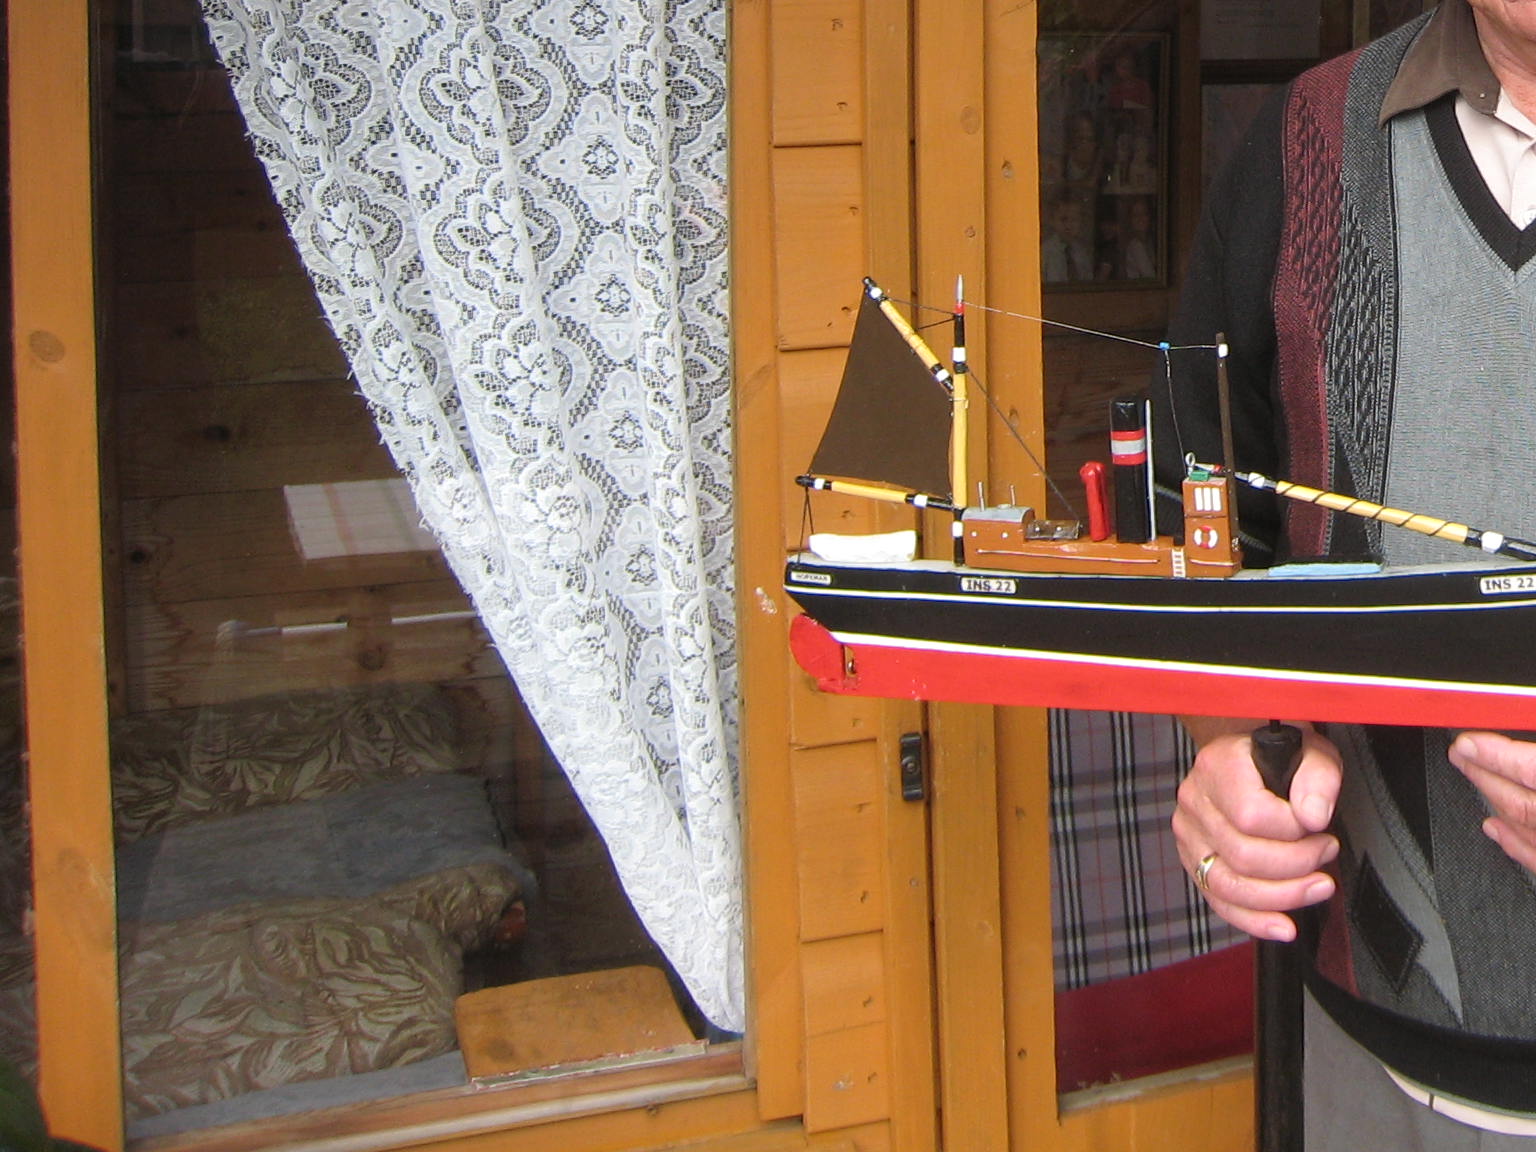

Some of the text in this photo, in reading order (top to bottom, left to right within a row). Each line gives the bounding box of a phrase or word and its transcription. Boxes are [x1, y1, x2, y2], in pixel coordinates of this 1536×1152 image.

[966, 579, 1012, 592] INS 22
[1485, 577, 1534, 591] INS 22
